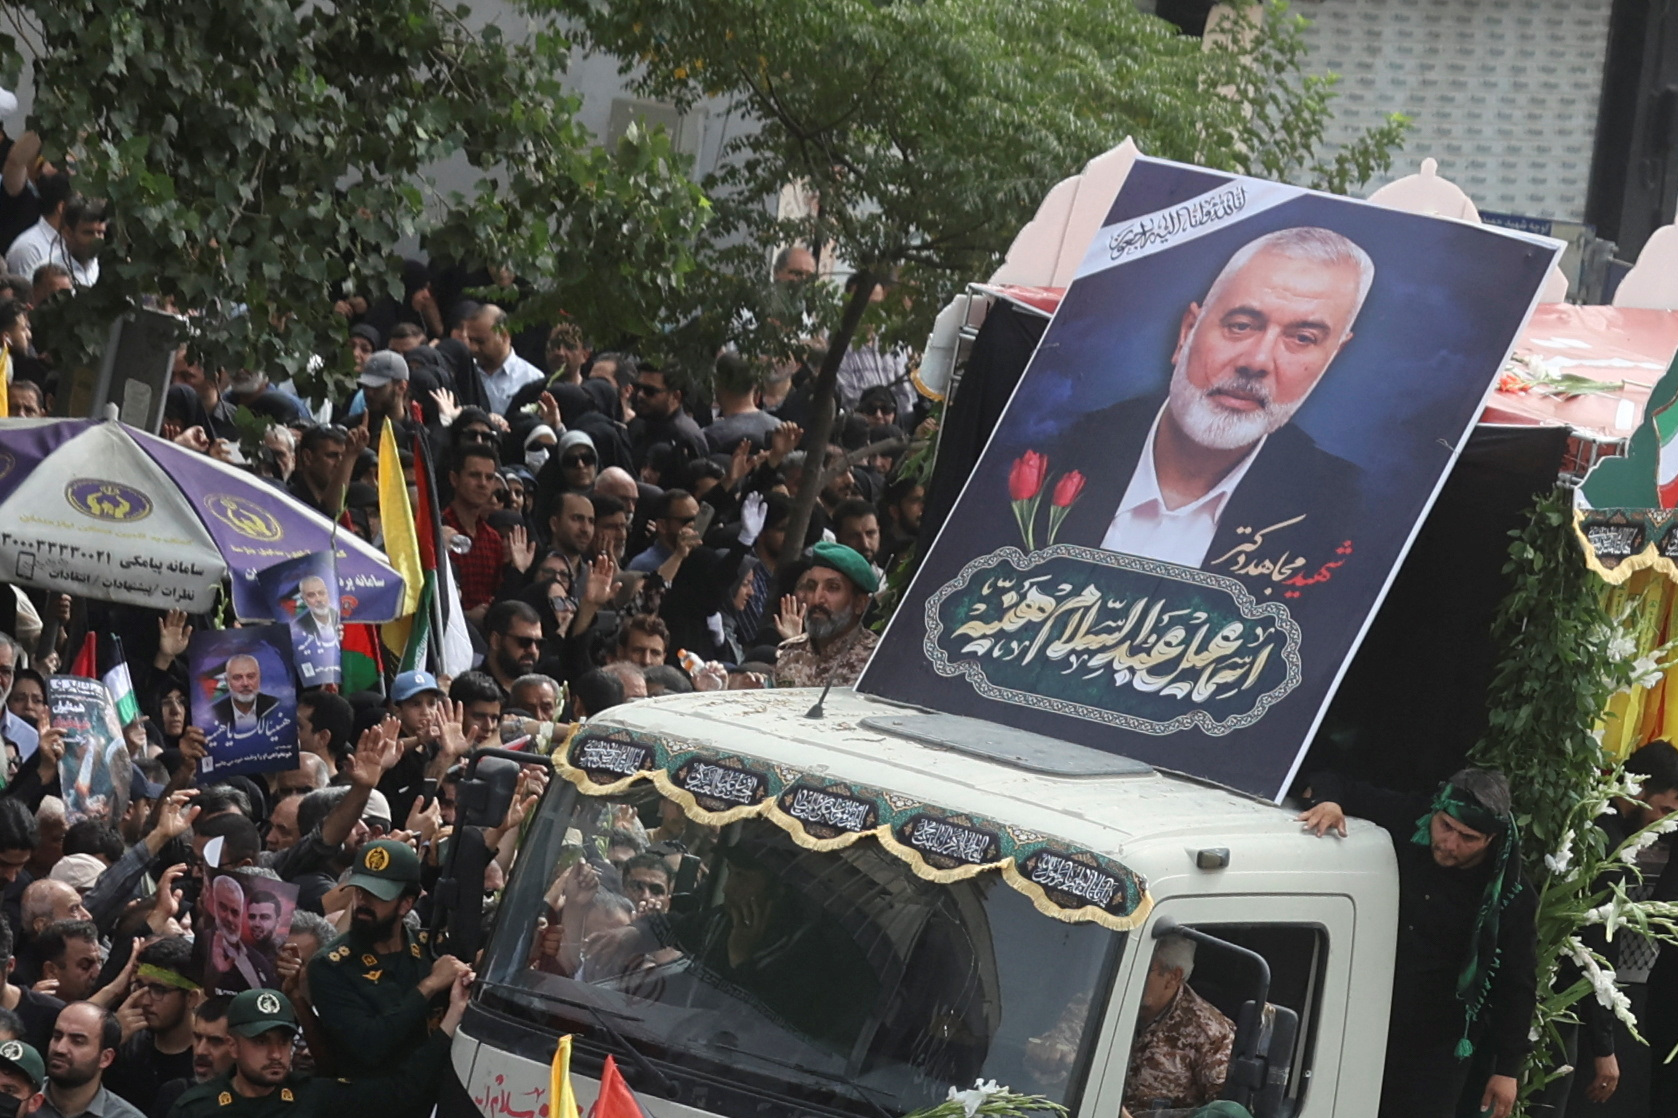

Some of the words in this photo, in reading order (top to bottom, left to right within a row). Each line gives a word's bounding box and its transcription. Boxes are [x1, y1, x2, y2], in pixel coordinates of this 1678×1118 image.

[1211, 513, 1307, 570] دکتر
[119, 555, 164, 575] پیامکی
[166, 561, 205, 577] سامانه
[1235, 551, 1307, 596] مجاهد
[1281, 540, 1353, 598] شهید
[49, 569, 91, 585] انتقادات
[355, 574, 385, 587] سامانه
[161, 586, 195, 602] نظرات
[1133, 620, 1275, 702] اسماعیل
